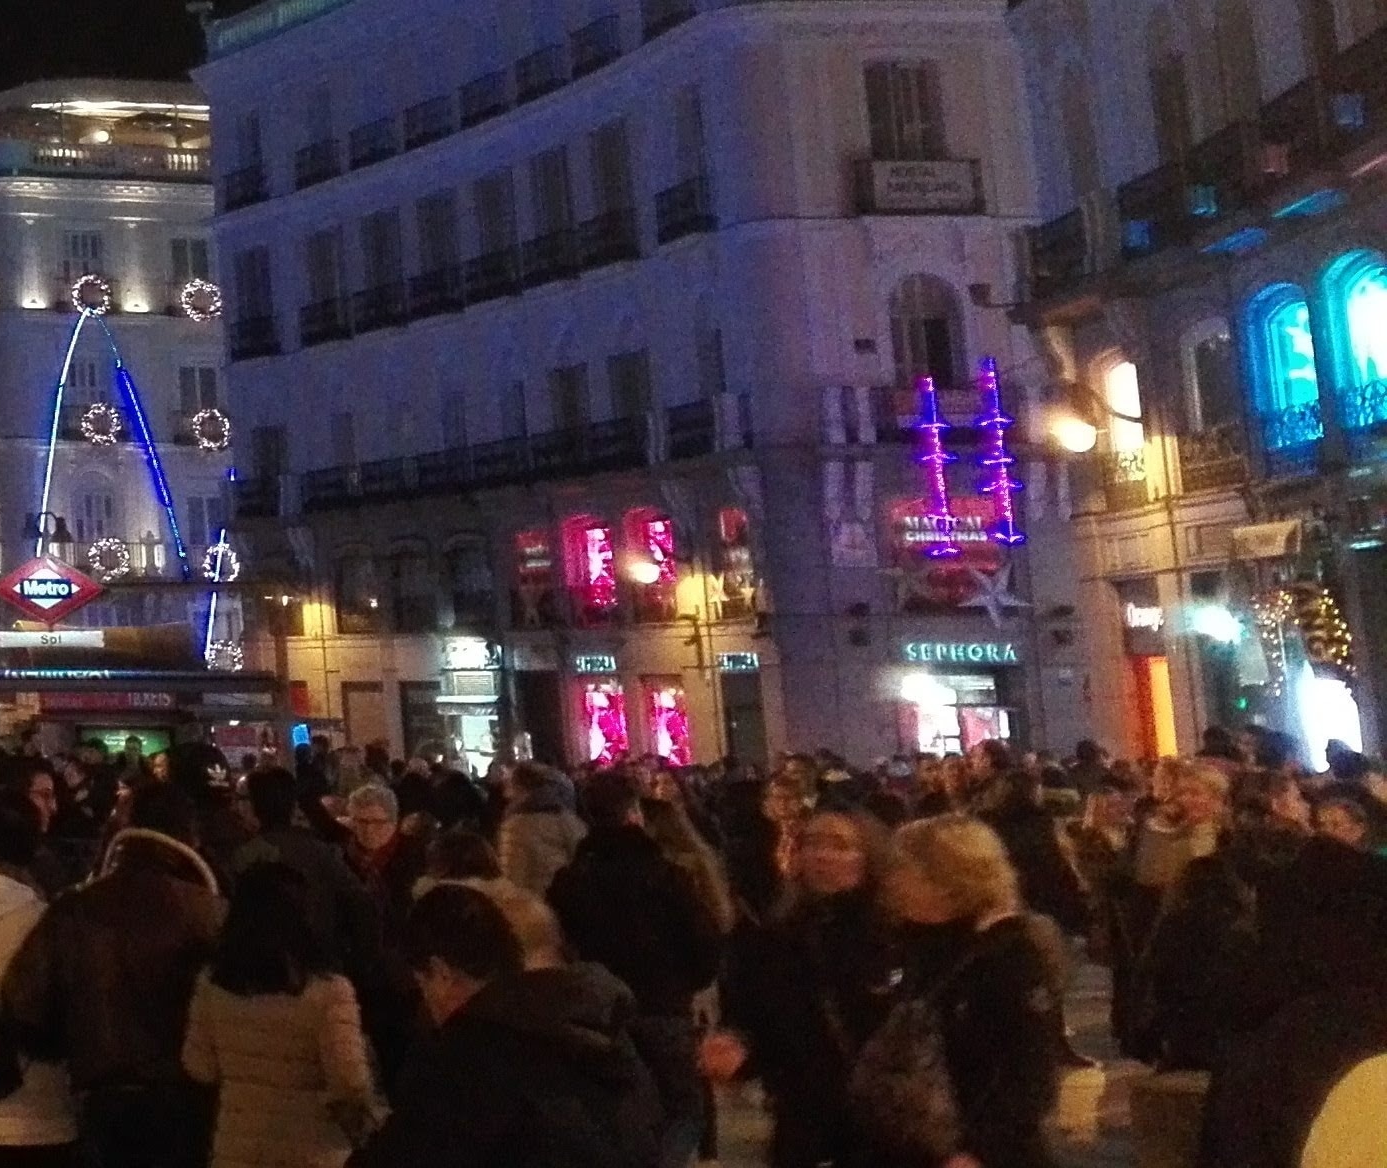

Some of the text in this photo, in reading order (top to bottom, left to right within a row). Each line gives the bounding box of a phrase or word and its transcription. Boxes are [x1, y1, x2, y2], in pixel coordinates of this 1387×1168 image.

[904, 516, 982, 529] MAGCAL
[23, 580, 70, 596] Metro
[40, 634, 63, 644] Sol
[906, 642, 1017, 662] SEPHORA
